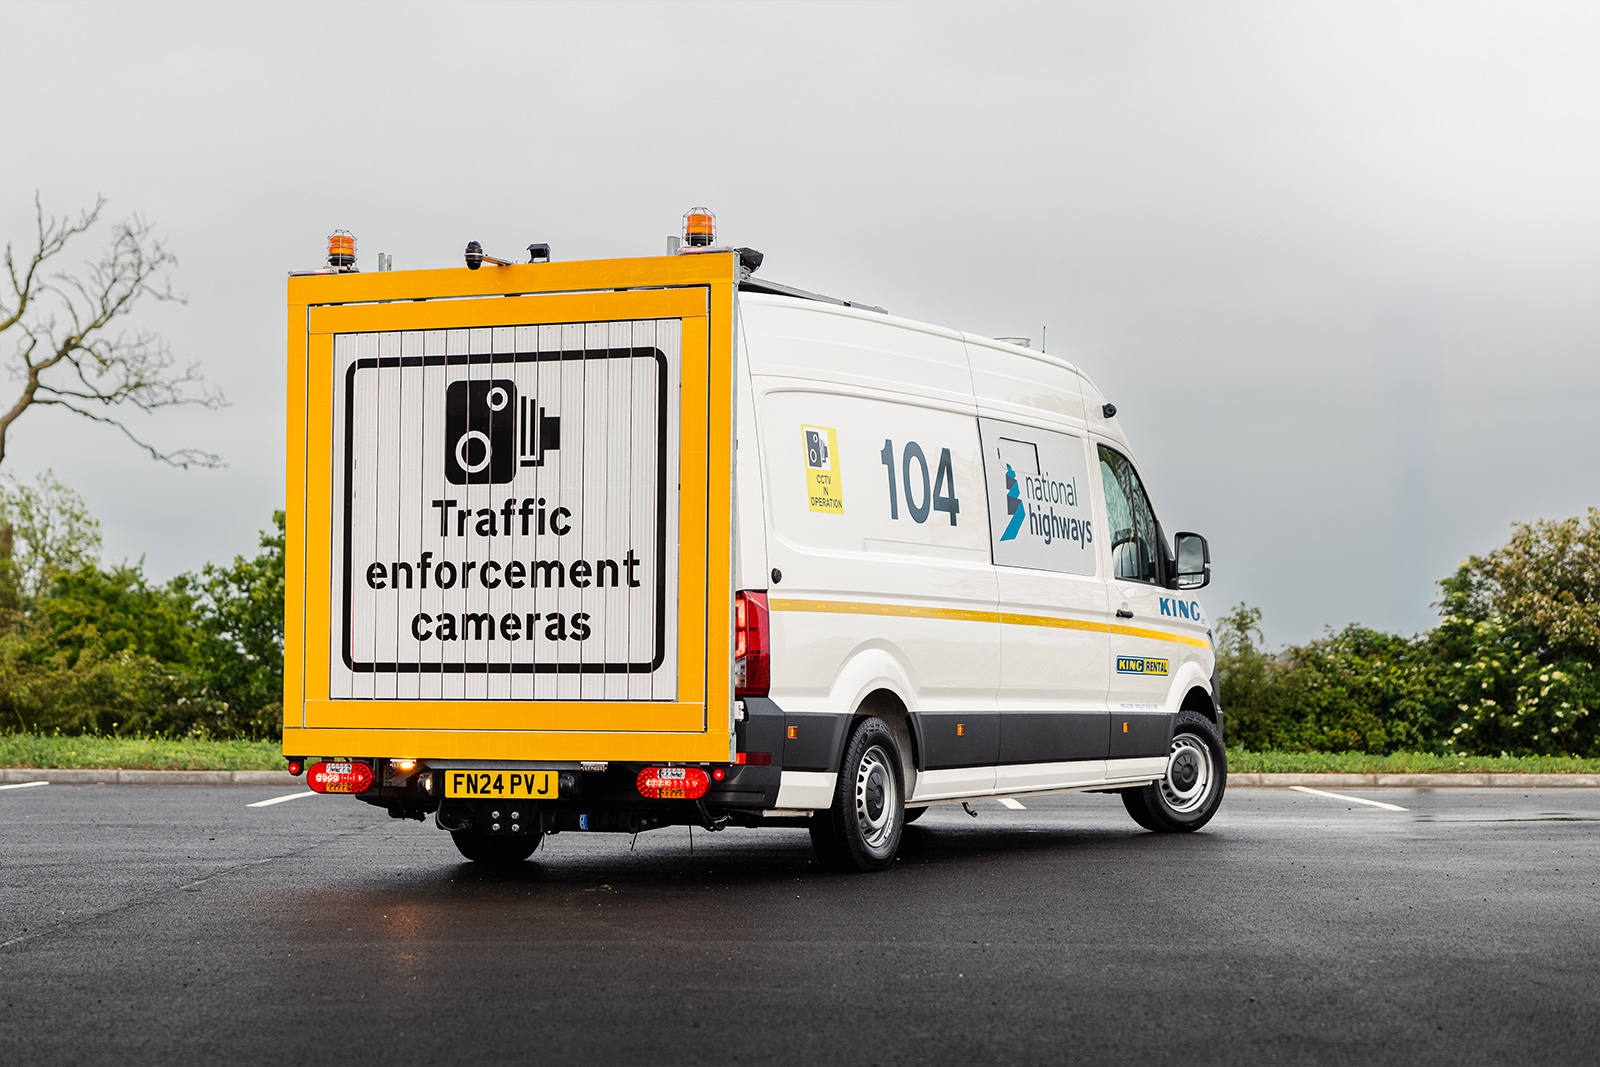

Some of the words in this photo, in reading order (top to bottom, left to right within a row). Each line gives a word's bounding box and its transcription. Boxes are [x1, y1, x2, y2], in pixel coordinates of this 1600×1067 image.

[816, 474, 832, 485] CCTV
[823, 486, 829, 496] IN
[880, 438, 960, 527] 104
[1024, 473, 1078, 508] national
[810, 496, 843, 509] OPERATION
[431, 497, 572, 537] Traffic
[1027, 503, 1093, 550] highways
[365, 549, 641, 590] enforcement
[1159, 597, 1201, 622] KING
[411, 612, 592, 642] cameras
[1119, 659, 1143, 672] KING
[1145, 661, 1168, 673] RENTAL
[453, 773, 504, 794] FN24
[510, 774, 549, 795] PVJ
